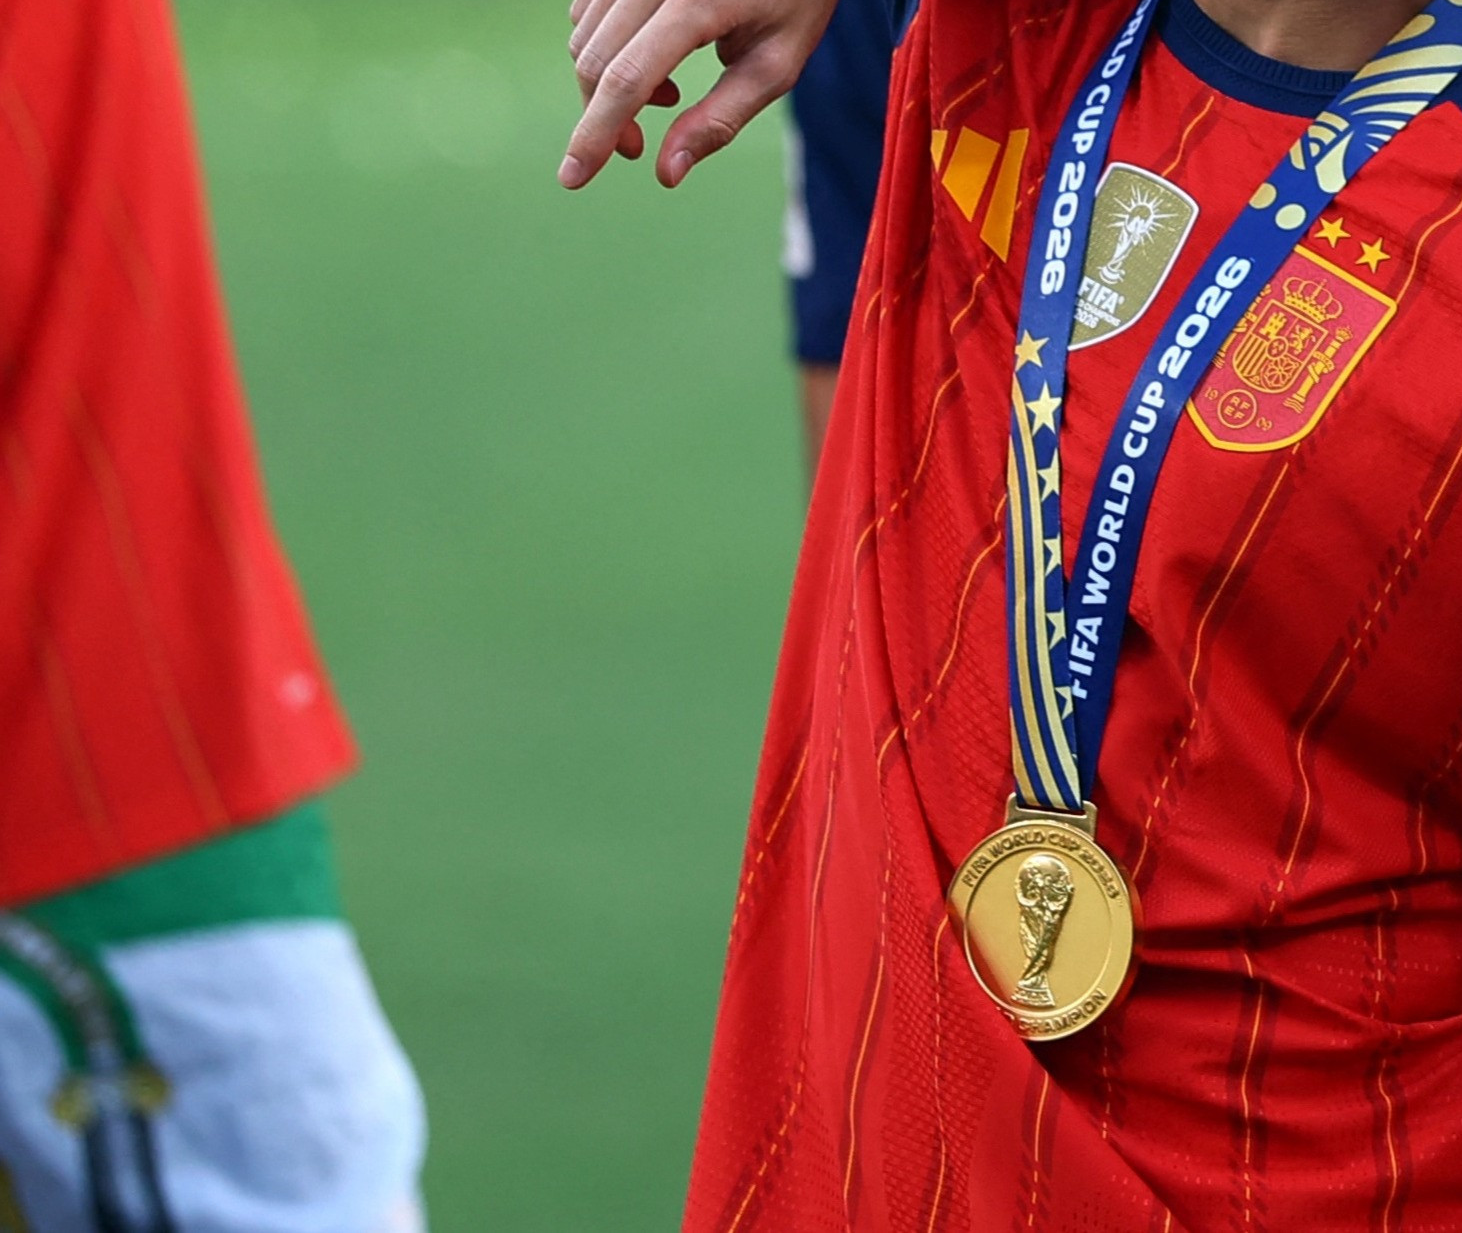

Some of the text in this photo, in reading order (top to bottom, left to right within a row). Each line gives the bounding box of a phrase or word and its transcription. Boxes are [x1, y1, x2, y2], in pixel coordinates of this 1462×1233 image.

[1072, 84, 1111, 154] CUP
[1040, 161, 1086, 295] 2026
[1068, 256, 1252, 700] FIFA WORLD CUP 2026
